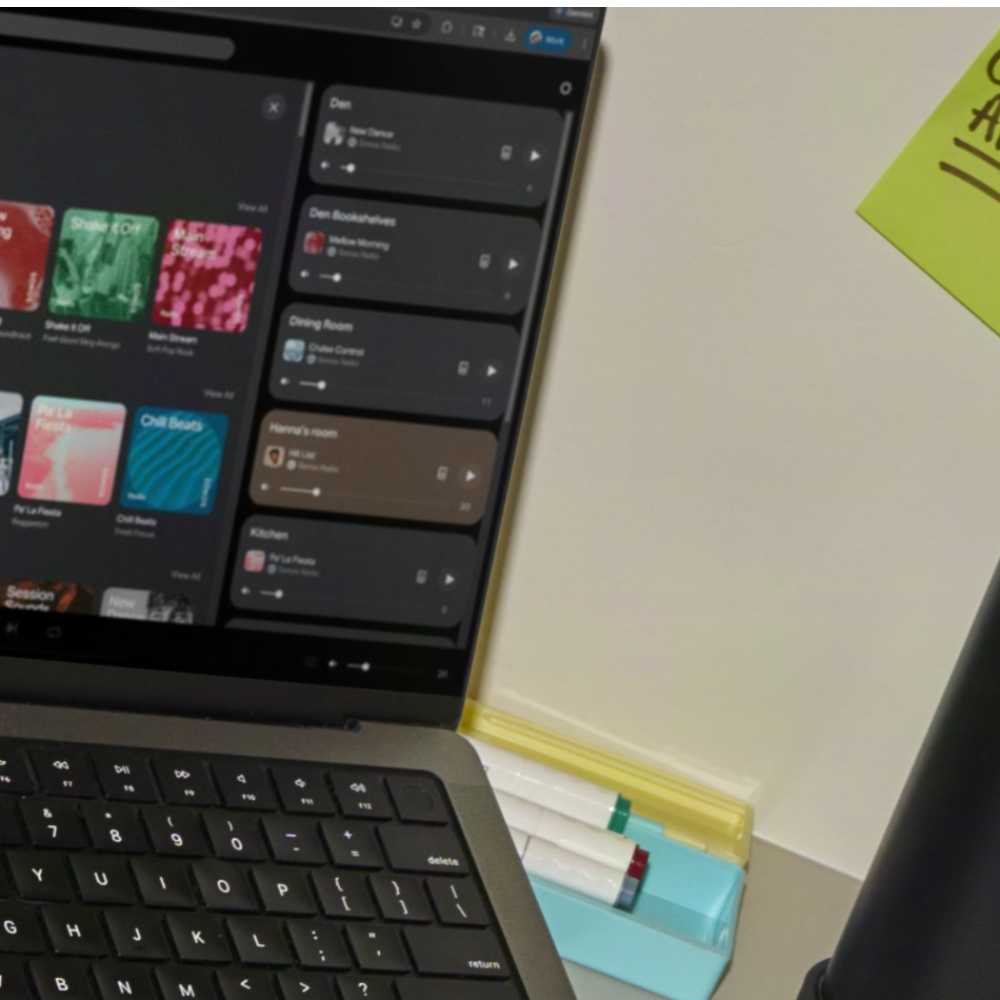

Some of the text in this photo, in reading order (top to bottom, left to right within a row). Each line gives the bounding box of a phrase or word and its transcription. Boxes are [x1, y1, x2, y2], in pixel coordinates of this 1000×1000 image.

[329, 96, 352, 110] Den
[309, 207, 397, 227] Den Bookshelves
[288, 315, 353, 332] Dining Room
[140, 413, 203, 432] Chill Beats
[269, 422, 338, 439] Hanna's room
[249, 527, 289, 541] Kitchen
[6, 585, 54, 601] Session
[47, 824, 58, 838] 7
[109, 828, 123, 843] 8
[170, 832, 183, 847] 9
[230, 837, 243, 851] 0
[427, 856, 460, 866] delete
[31, 868, 43, 882] Y
[93, 871, 109, 886] U
[216, 879, 231, 894] O
[277, 883, 289, 897] P
[3, 919, 18, 935] G
[66, 924, 81, 938] H
[132, 927, 142, 942] J
[191, 931, 205, 944] K
[252, 934, 265, 948] L
[468, 960, 501, 969] return
[55, 977, 69, 992] B
[117, 980, 133, 995] N
[178, 983, 195, 997] M
